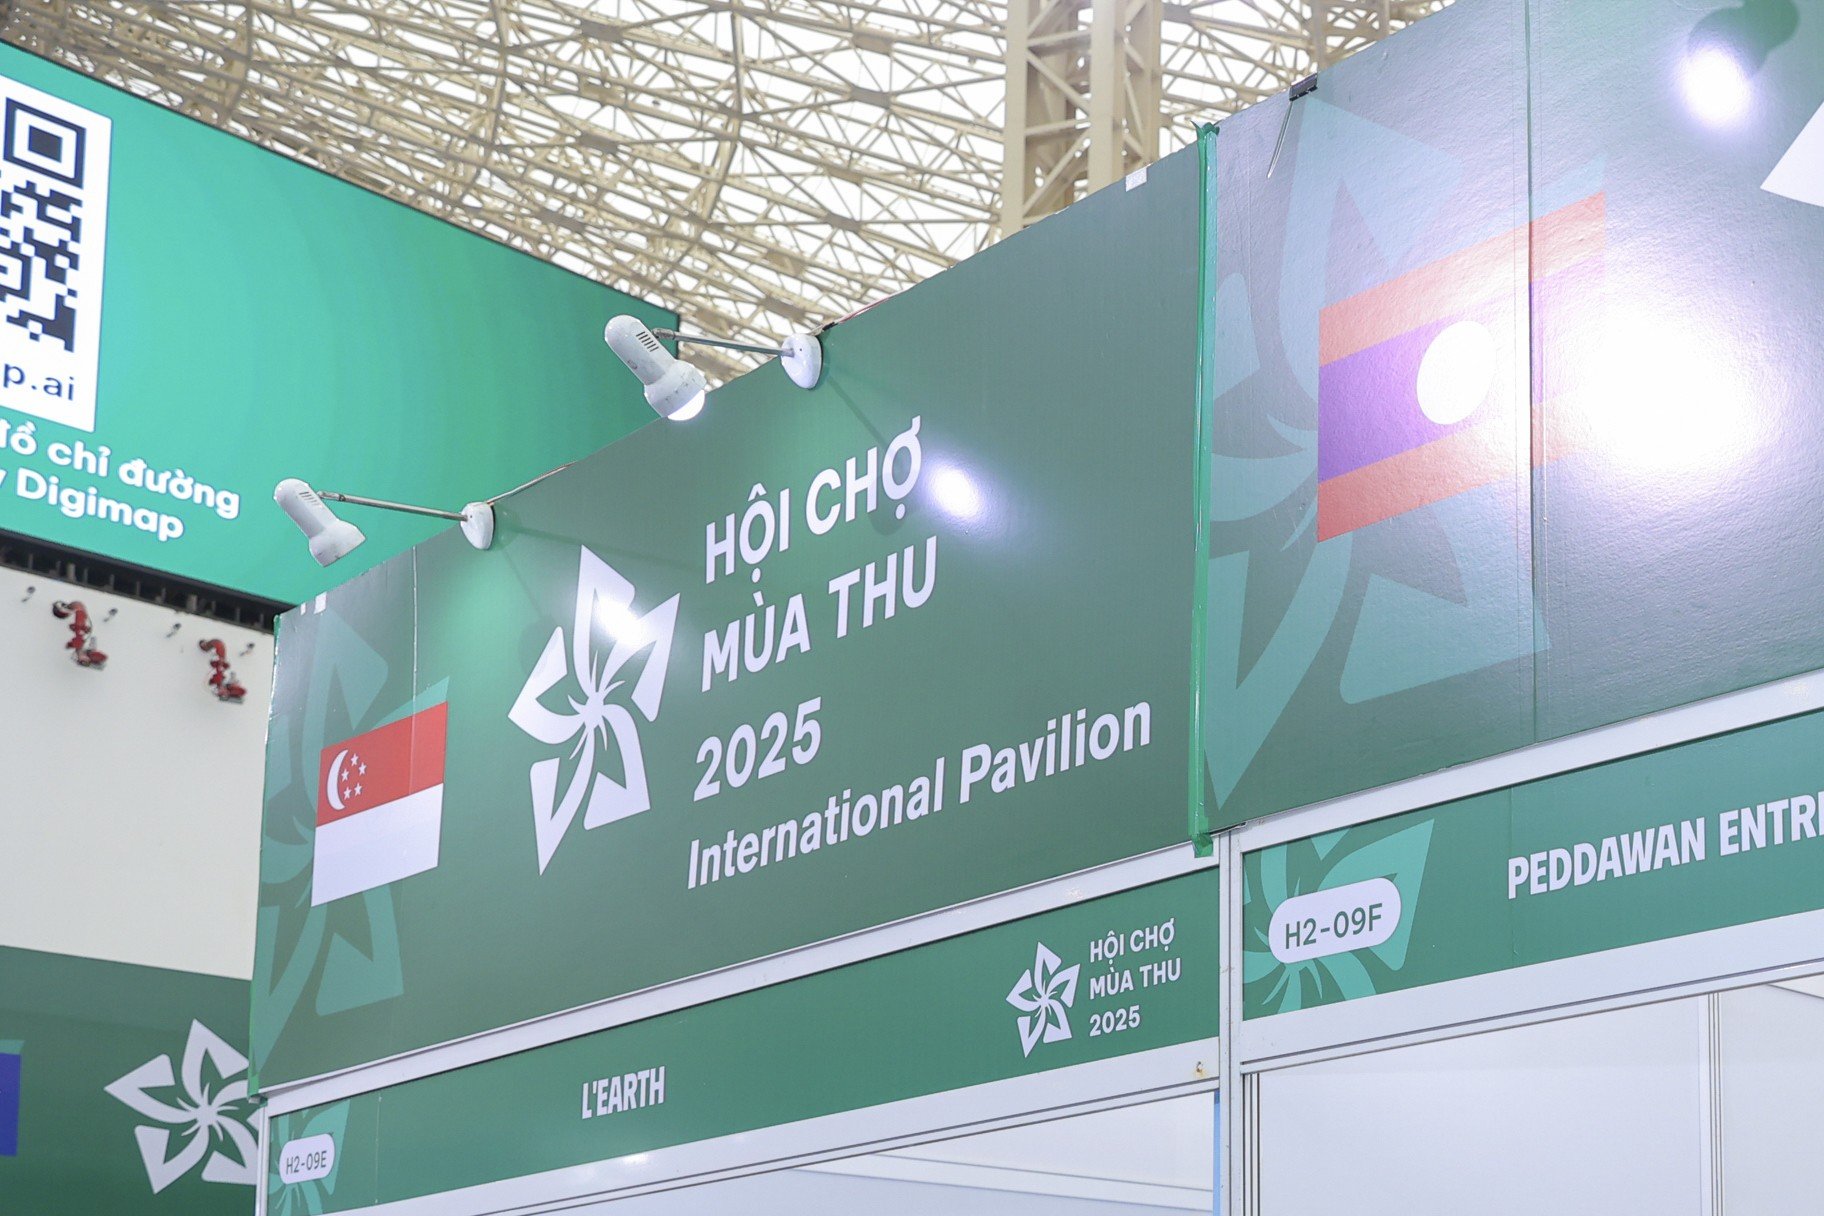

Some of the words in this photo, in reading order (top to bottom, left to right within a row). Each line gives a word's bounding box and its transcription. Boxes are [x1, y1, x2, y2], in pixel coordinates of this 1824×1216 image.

[17, 467, 184, 542] Digimap
[48, 440, 112, 477] chỉ
[118, 458, 240, 520] đường
[704, 483, 790, 584] HỘI
[805, 415, 923, 536] CHỢ
[701, 592, 811, 692] MÙA
[828, 536, 938, 639] THU
[693, 697, 823, 802] 2025
[686, 757, 944, 890] International
[958, 701, 1152, 804] Pavilion
[1508, 816, 1707, 900] PEDDAWAN
[1089, 930, 1127, 966] HỘI
[1130, 917, 1176, 956] CHỢ
[1285, 902, 1383, 950] H2-09F
[1088, 967, 1135, 1000] MÙA
[1140, 957, 1181, 990] THU
[1088, 1005, 1141, 1037] 2025
[581, 1066, 666, 1120] L'EARTH
[286, 1148, 328, 1176] H2-09E
